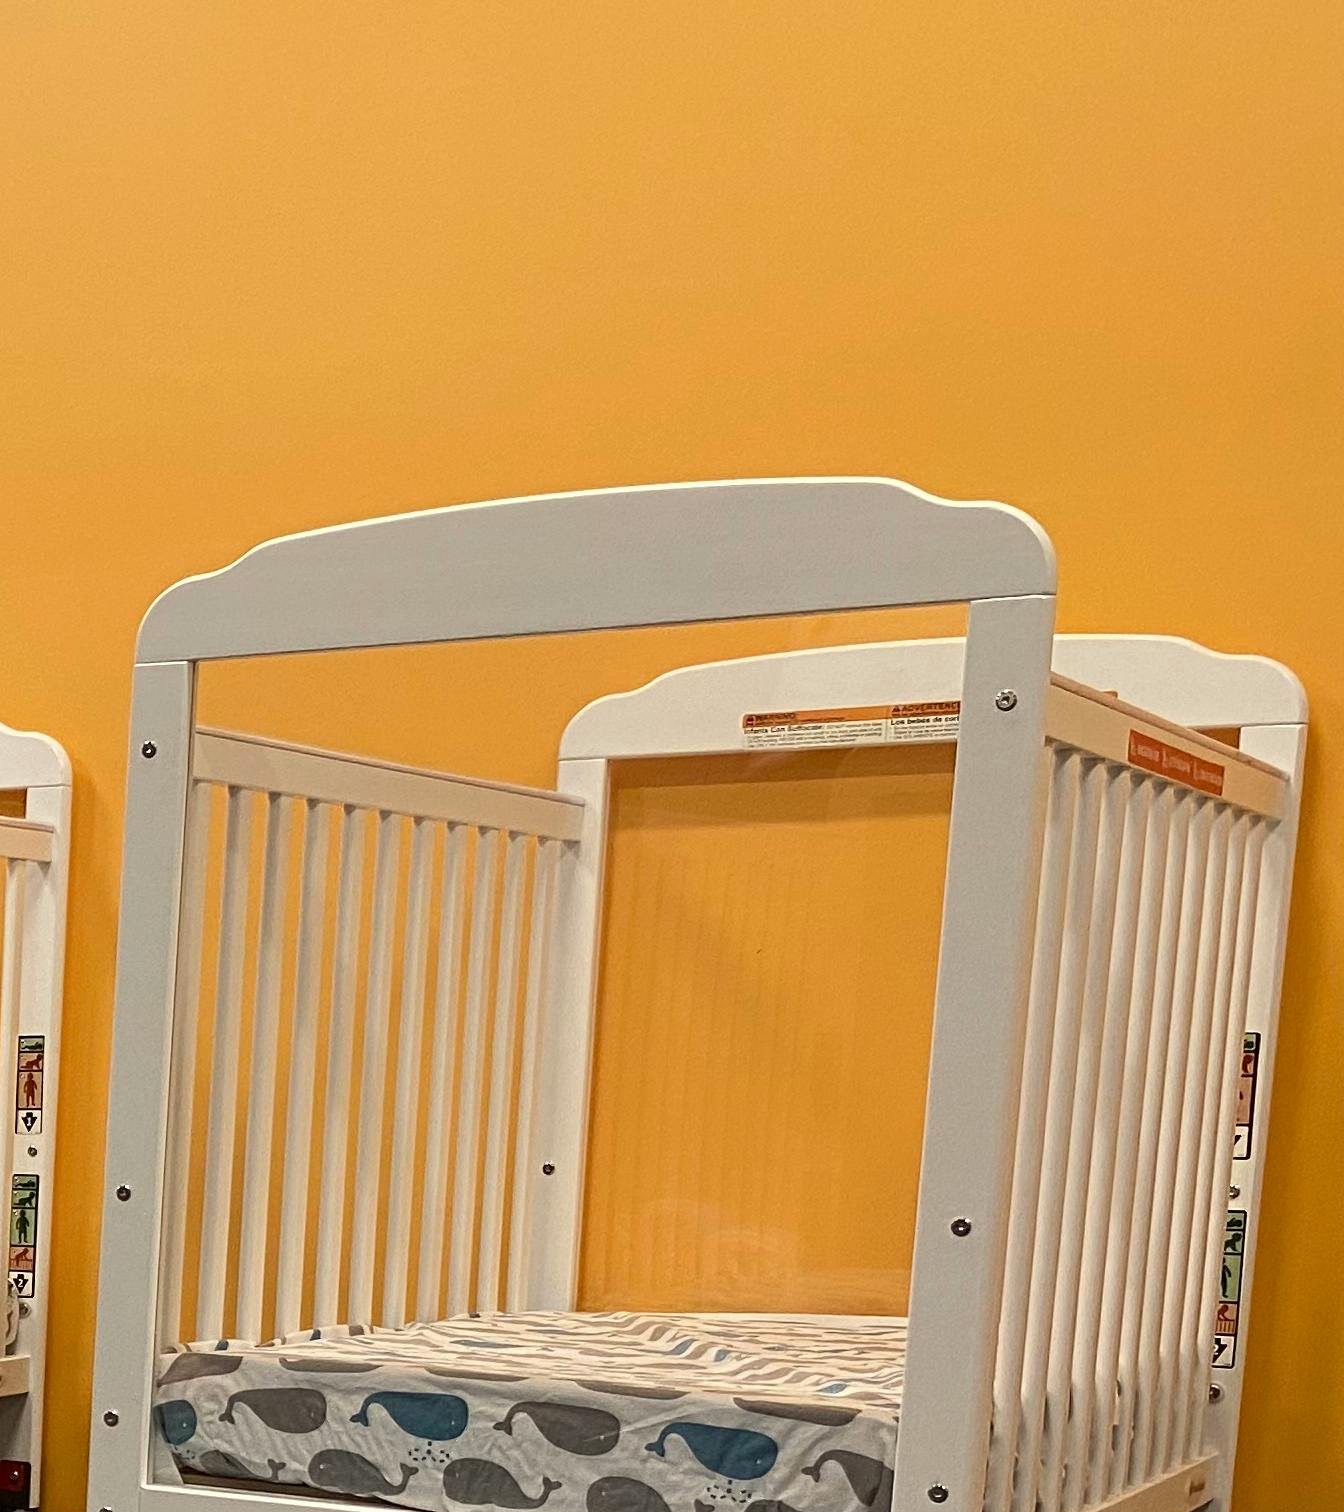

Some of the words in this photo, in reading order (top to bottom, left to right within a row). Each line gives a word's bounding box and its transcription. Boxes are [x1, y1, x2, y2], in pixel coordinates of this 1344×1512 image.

[901, 701, 960, 712] ADVERTENC
[26, 1116, 32, 1127] 1
[17, 1278, 24, 1288] 2
